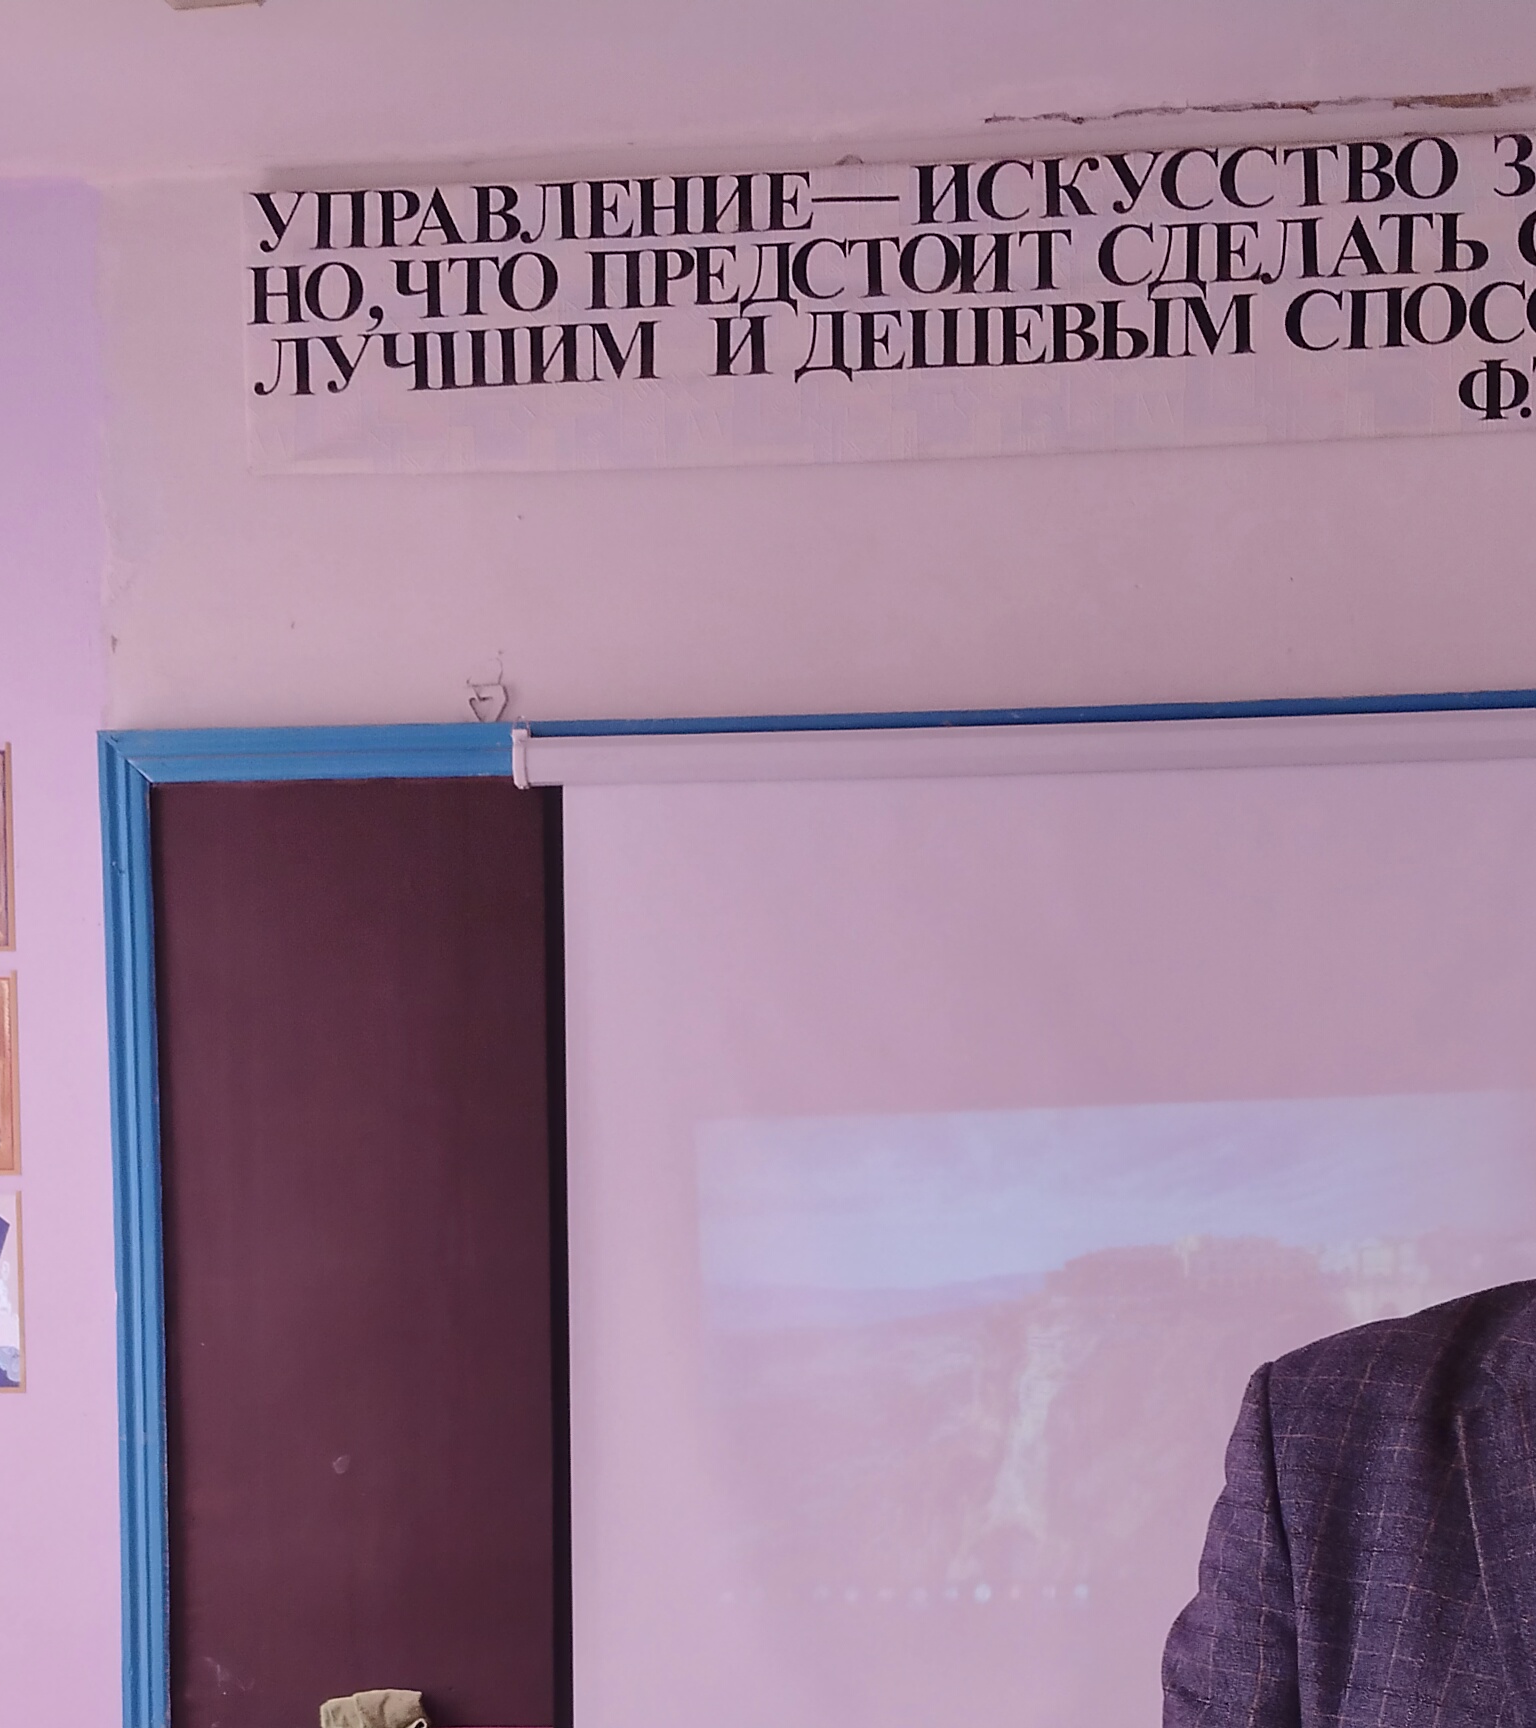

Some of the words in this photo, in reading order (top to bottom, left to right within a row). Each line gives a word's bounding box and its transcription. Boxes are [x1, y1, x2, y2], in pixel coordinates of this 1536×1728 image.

[585, 229, 1072, 311] ПРЕДСТОИТ
[1098, 212, 1489, 288] СДЕЛАТЬ
[254, 321, 660, 396] ЛУЧШИМ
[713, 315, 775, 376] И
[795, 286, 1255, 383] ДЕШЕВЫМ
